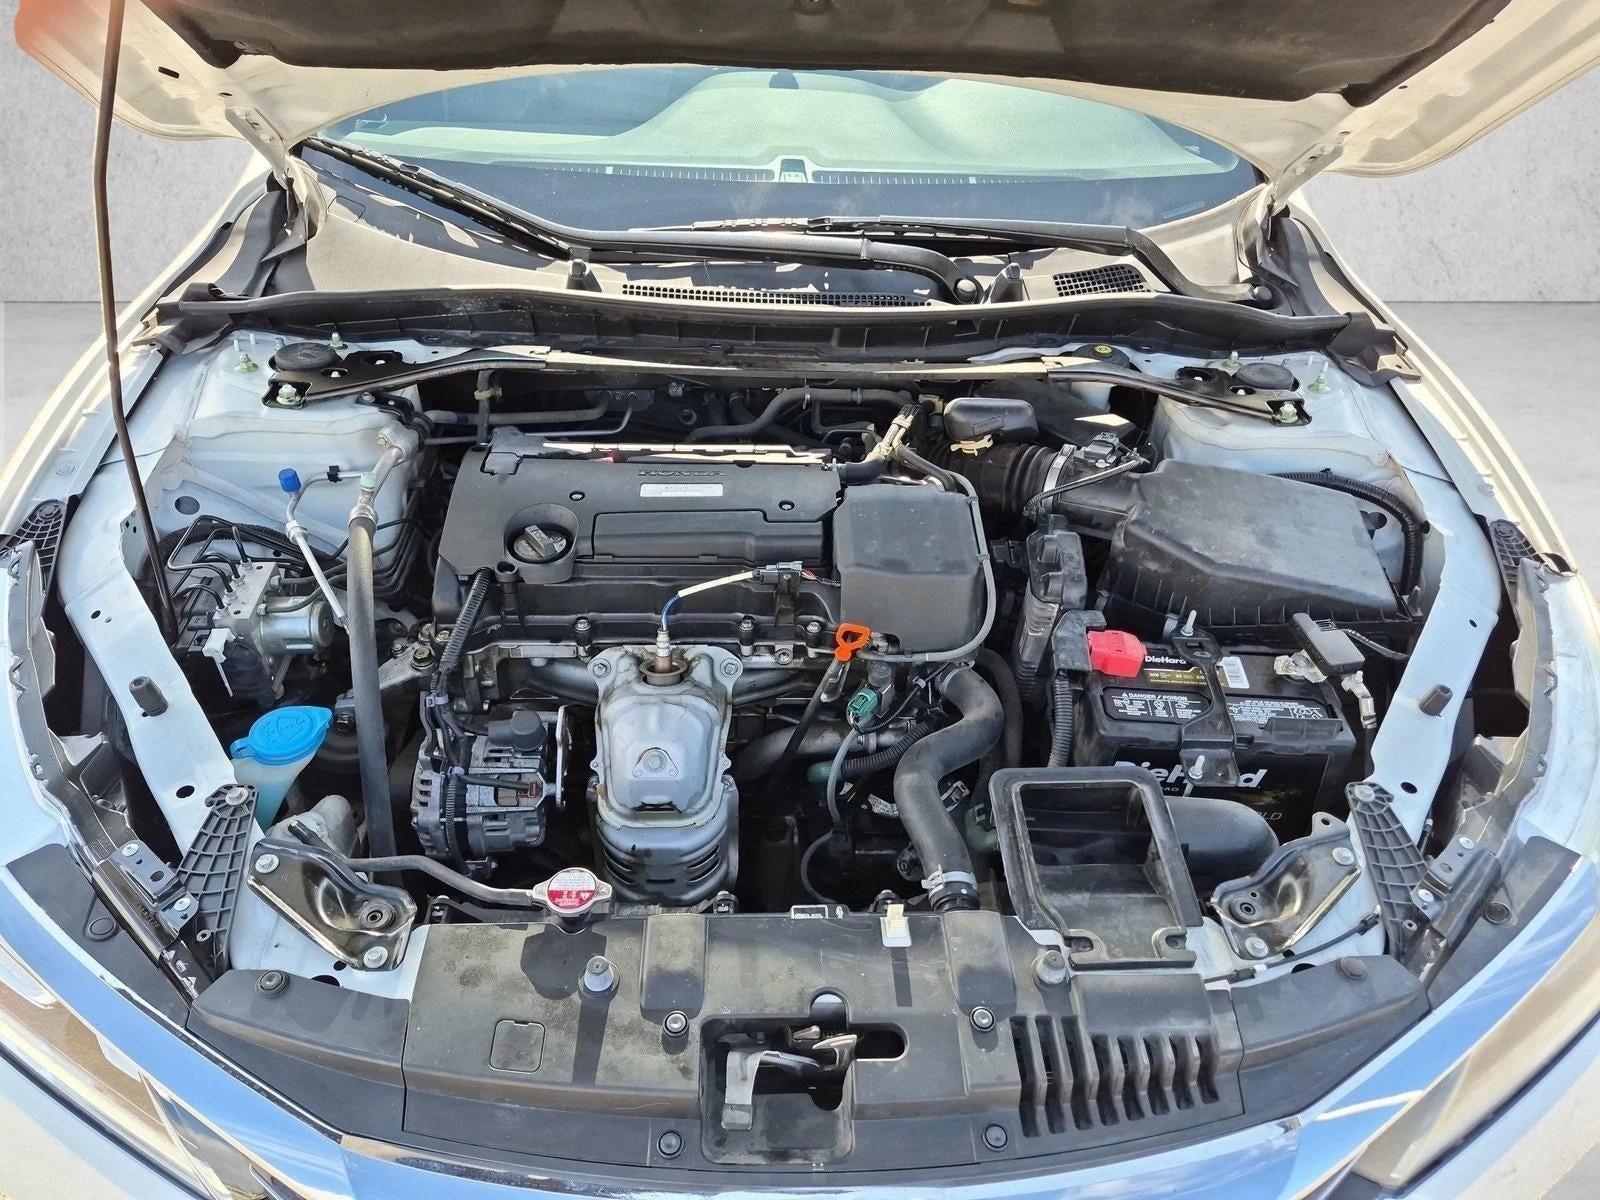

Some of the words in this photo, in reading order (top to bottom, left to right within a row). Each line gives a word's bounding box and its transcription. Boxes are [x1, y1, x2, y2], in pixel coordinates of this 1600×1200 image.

[638, 469, 727, 477] HONDA
[1129, 692, 1156, 700] DANGER
[1163, 694, 1188, 702] POISON
